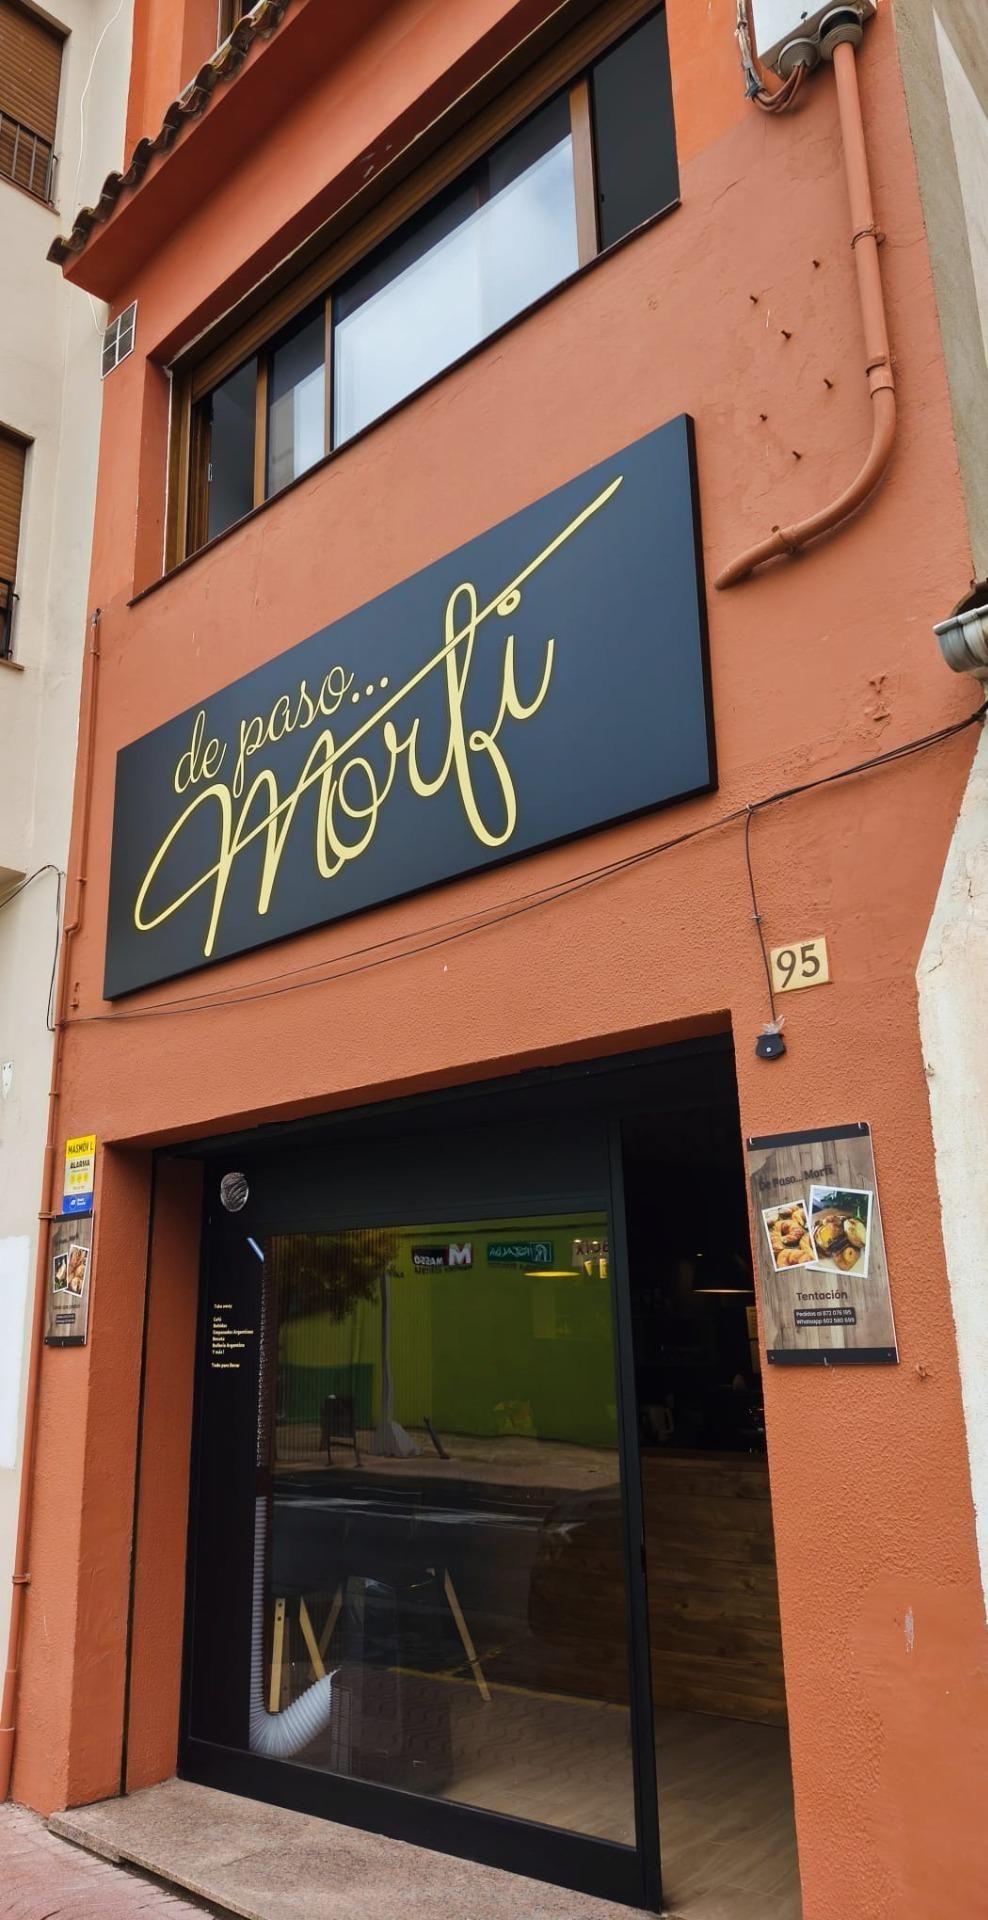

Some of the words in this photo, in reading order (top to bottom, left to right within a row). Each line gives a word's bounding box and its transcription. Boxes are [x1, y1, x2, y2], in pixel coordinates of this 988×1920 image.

[134, 475, 624, 958] Morfi
[173, 710, 227, 794] de
[776, 943, 821, 989] 95
[804, 1164, 834, 1180] Morfi
[796, 1289, 848, 1301] Tentación
